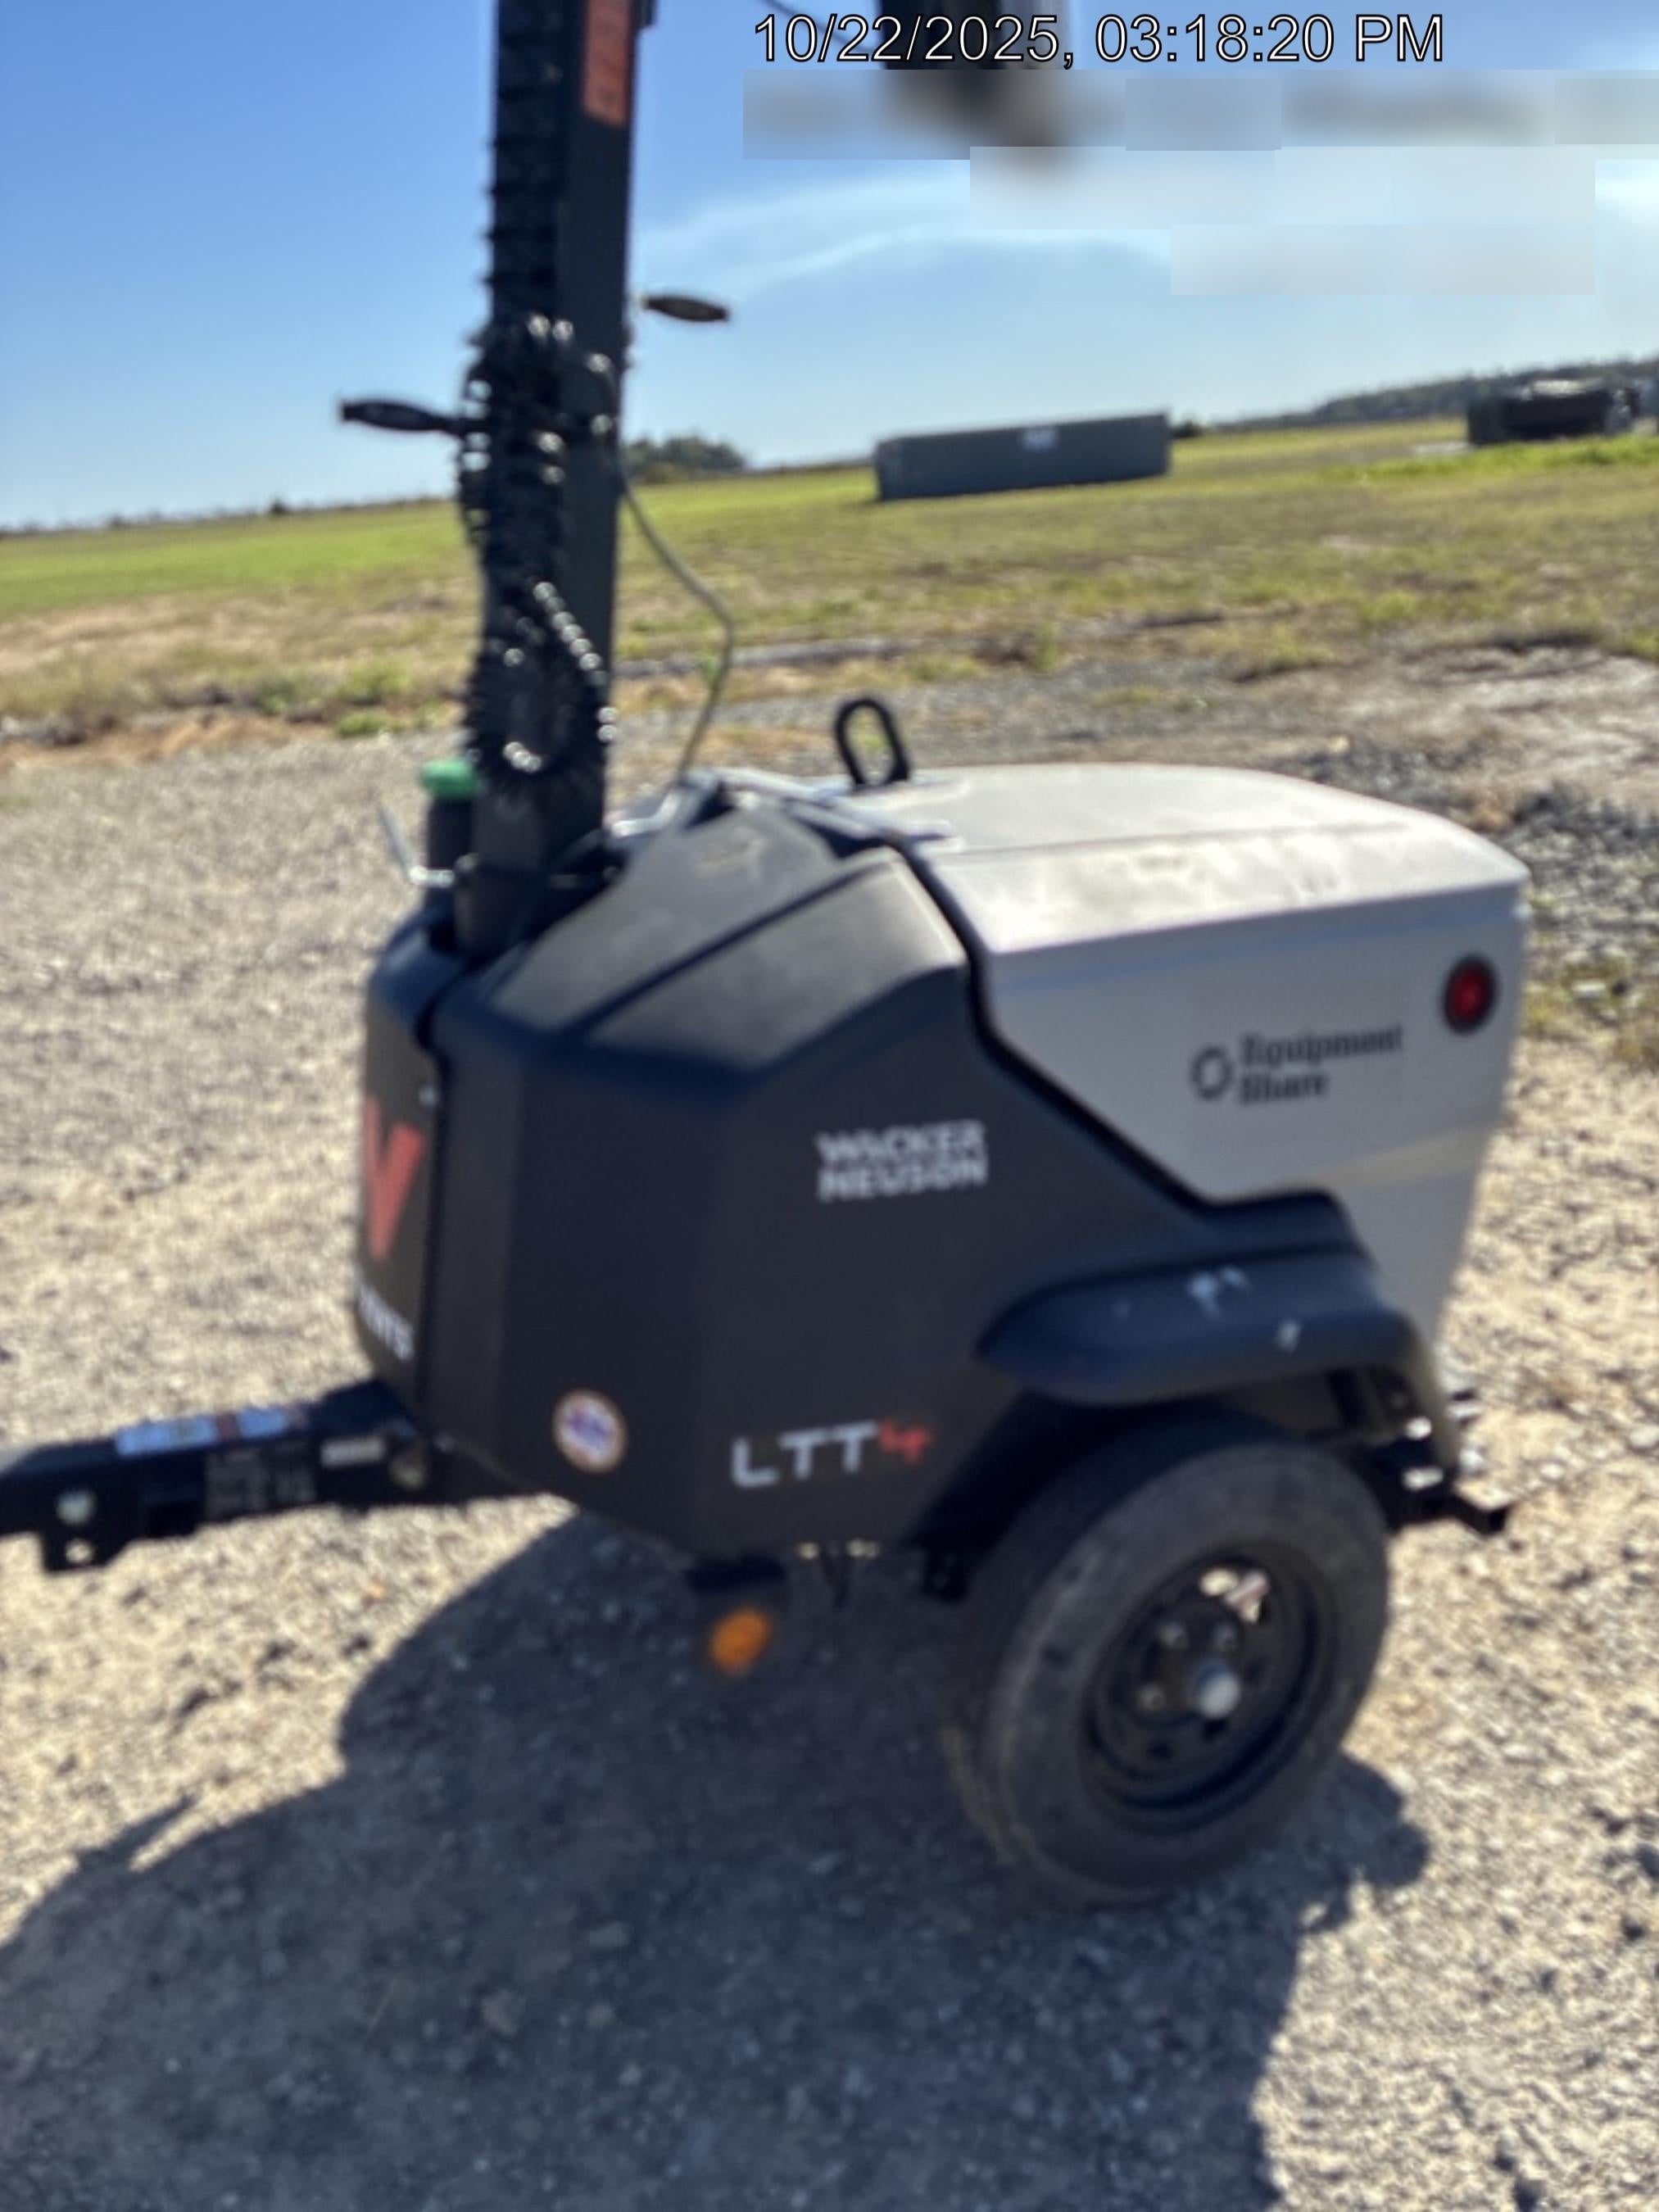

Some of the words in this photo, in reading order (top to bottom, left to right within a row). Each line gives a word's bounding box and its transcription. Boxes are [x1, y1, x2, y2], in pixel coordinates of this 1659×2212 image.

[1238, 1024, 1403, 1067] Equipment
[1239, 1072, 1329, 1106] Share
[816, 1119, 986, 1164] WACKER
[818, 1148, 989, 1201] NEUSON
[732, 1419, 931, 1488] LTT4
